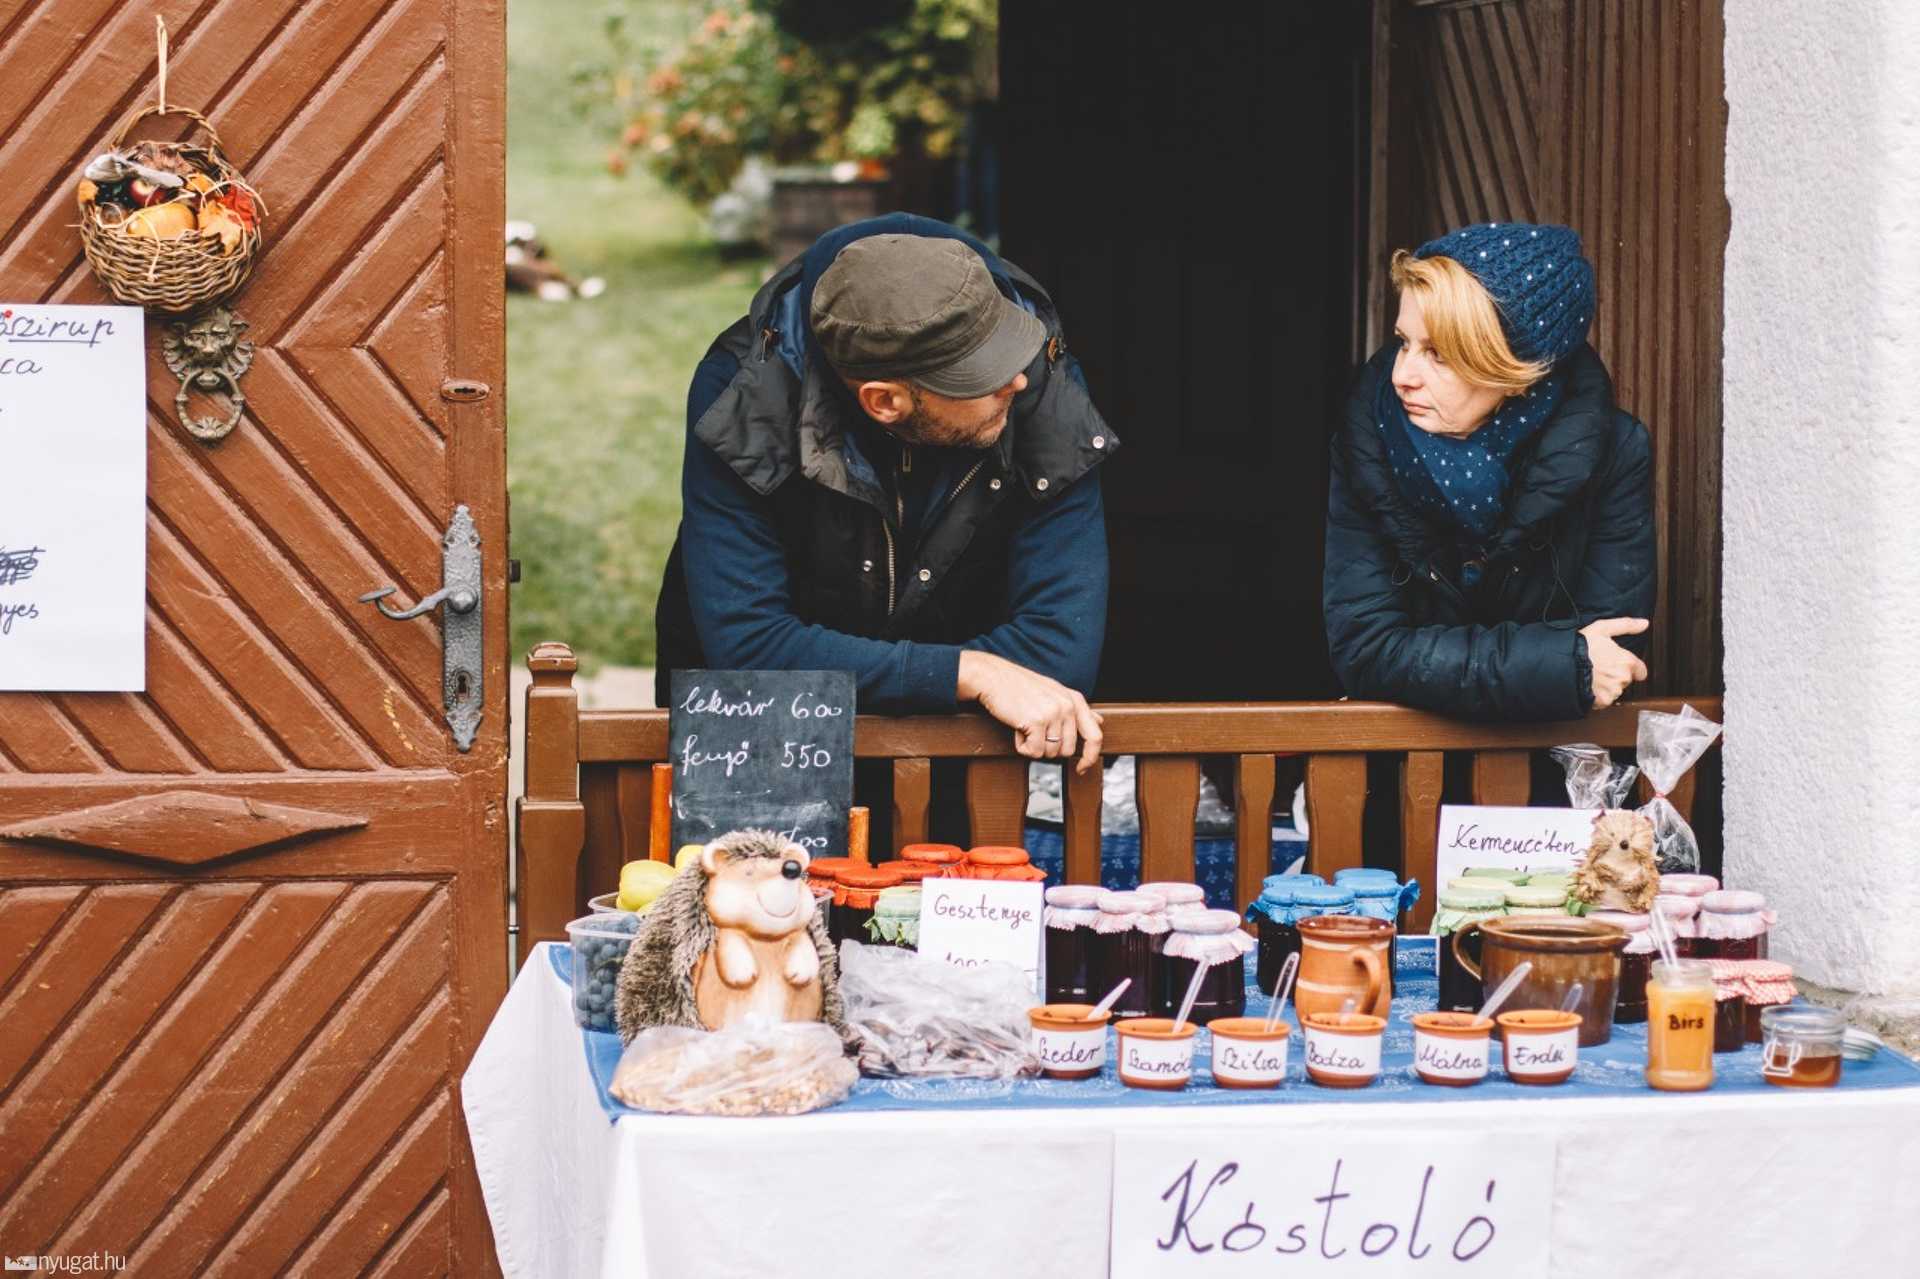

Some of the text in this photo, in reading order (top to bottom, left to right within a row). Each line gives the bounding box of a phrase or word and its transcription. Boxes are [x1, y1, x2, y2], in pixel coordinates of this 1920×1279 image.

[680, 686, 843, 719] lekvár 600
[781, 741, 831, 769] 550
[934, 893, 1033, 930] Gesztenye
[1667, 1013, 1705, 1031] Birs
[1039, 1036, 1101, 1064] Szeder
[1220, 1047, 1282, 1071] Szilva
[1306, 1040, 1367, 1069] Bodza
[1418, 1043, 1483, 1070] Málna
[1157, 1158, 1496, 1262] Kóstoló
